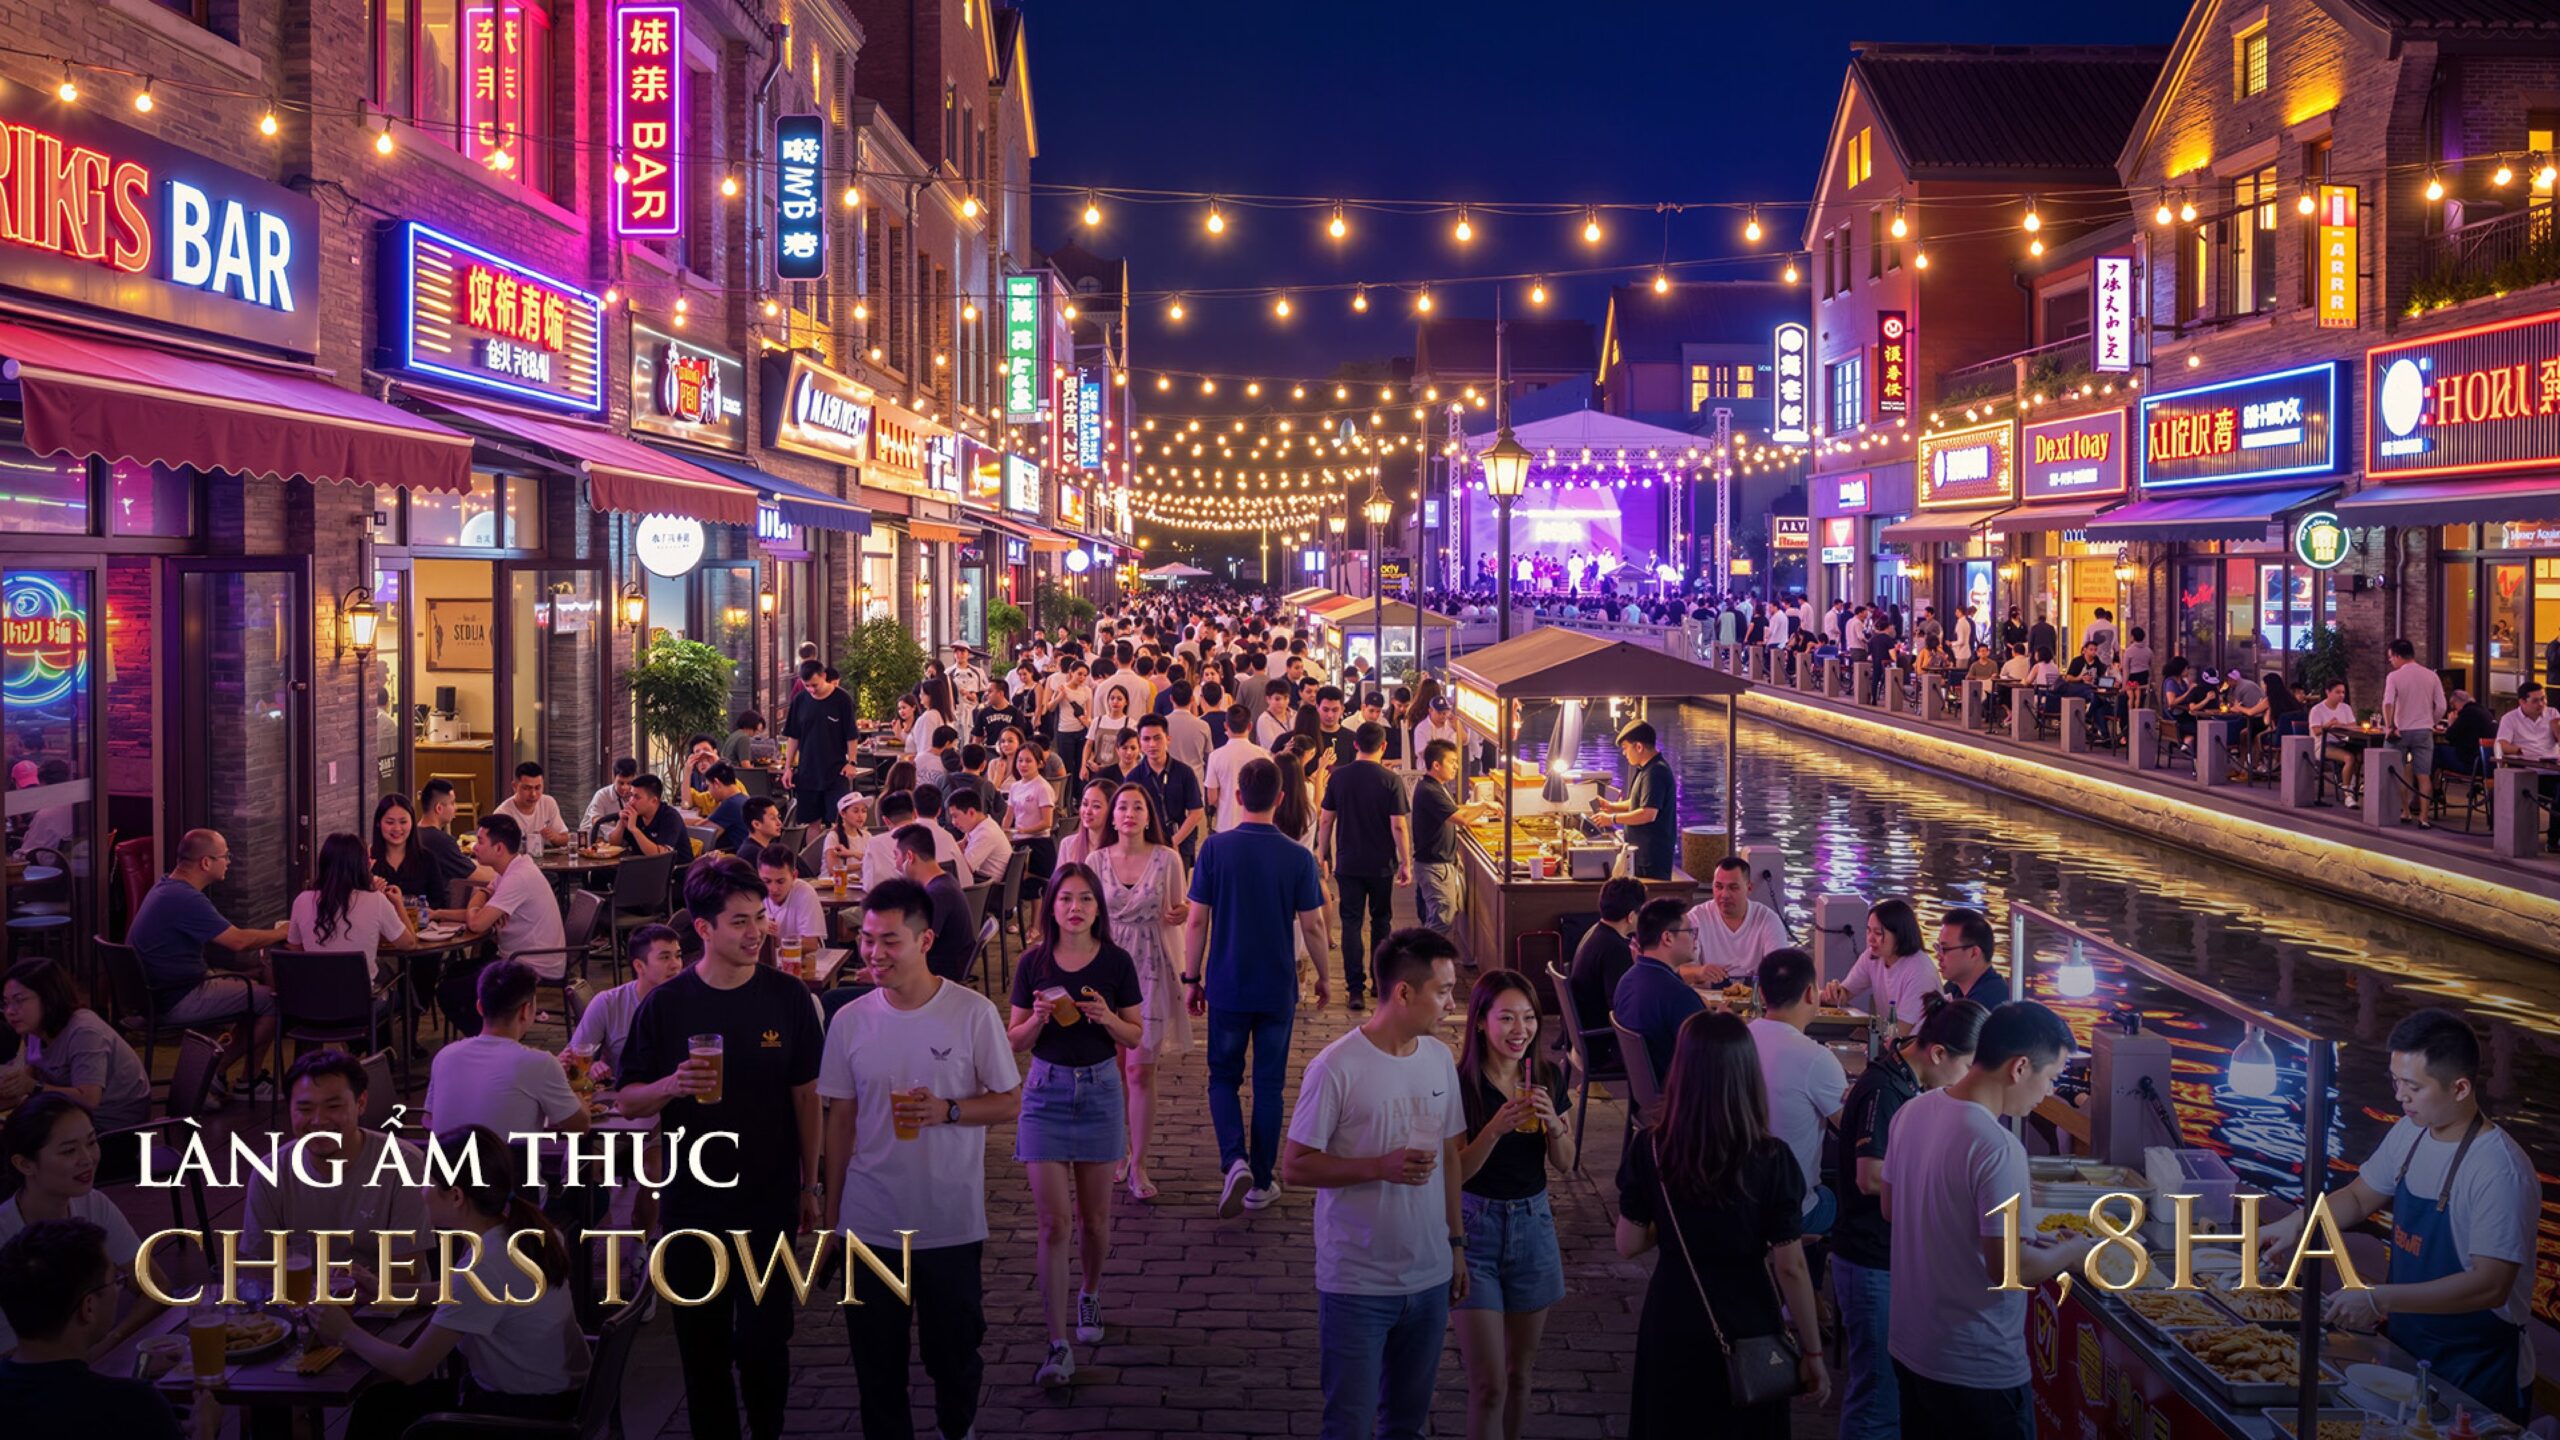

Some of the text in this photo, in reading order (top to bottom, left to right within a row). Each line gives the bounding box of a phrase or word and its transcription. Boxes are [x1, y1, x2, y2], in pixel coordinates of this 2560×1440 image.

[632, 122, 667, 220] BAR
[172, 180, 296, 312] BAR
[2035, 432, 2071, 464] Dext
